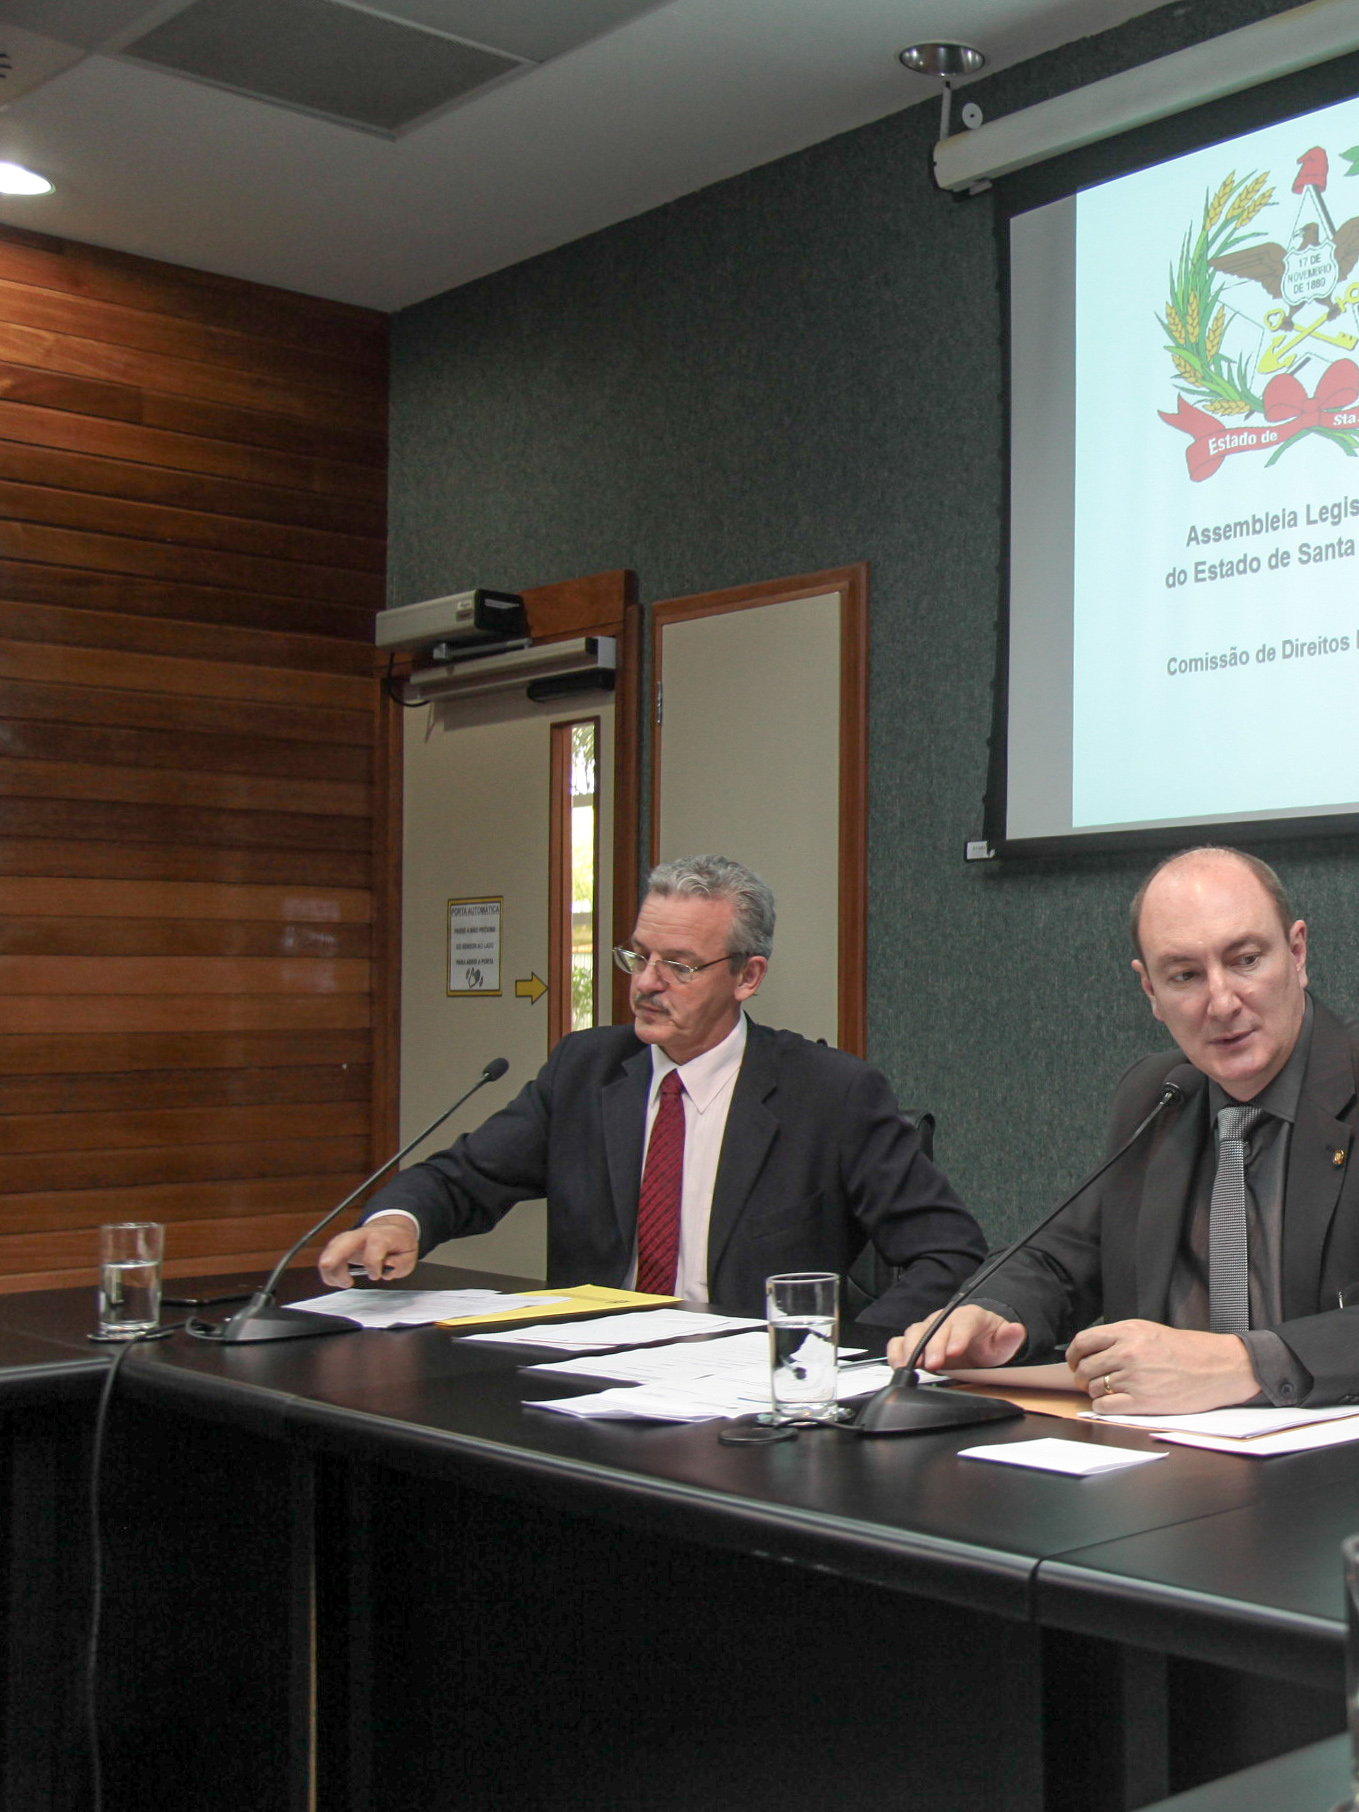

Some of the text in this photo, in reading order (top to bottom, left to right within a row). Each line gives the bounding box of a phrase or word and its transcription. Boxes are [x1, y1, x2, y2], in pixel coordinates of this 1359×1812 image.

[1299, 254, 1321, 267] 17 DE
[1287, 263, 1332, 283] NOVEMBRO
[1293, 277, 1326, 294] DE 1889
[1208, 431, 1257, 455] Estado
[1261, 430, 1278, 442] de
[1186, 508, 1298, 547] Assembleia
[1165, 567, 1188, 589] do
[1193, 553, 1261, 584] Estado
[1267, 548, 1291, 570] de
[1298, 536, 1355, 565] Santa
[1167, 646, 1250, 676] Comissão
[1255, 643, 1277, 663] de
[1282, 633, 1350, 660] Direitos
[451, 907, 467, 916] PORTA
